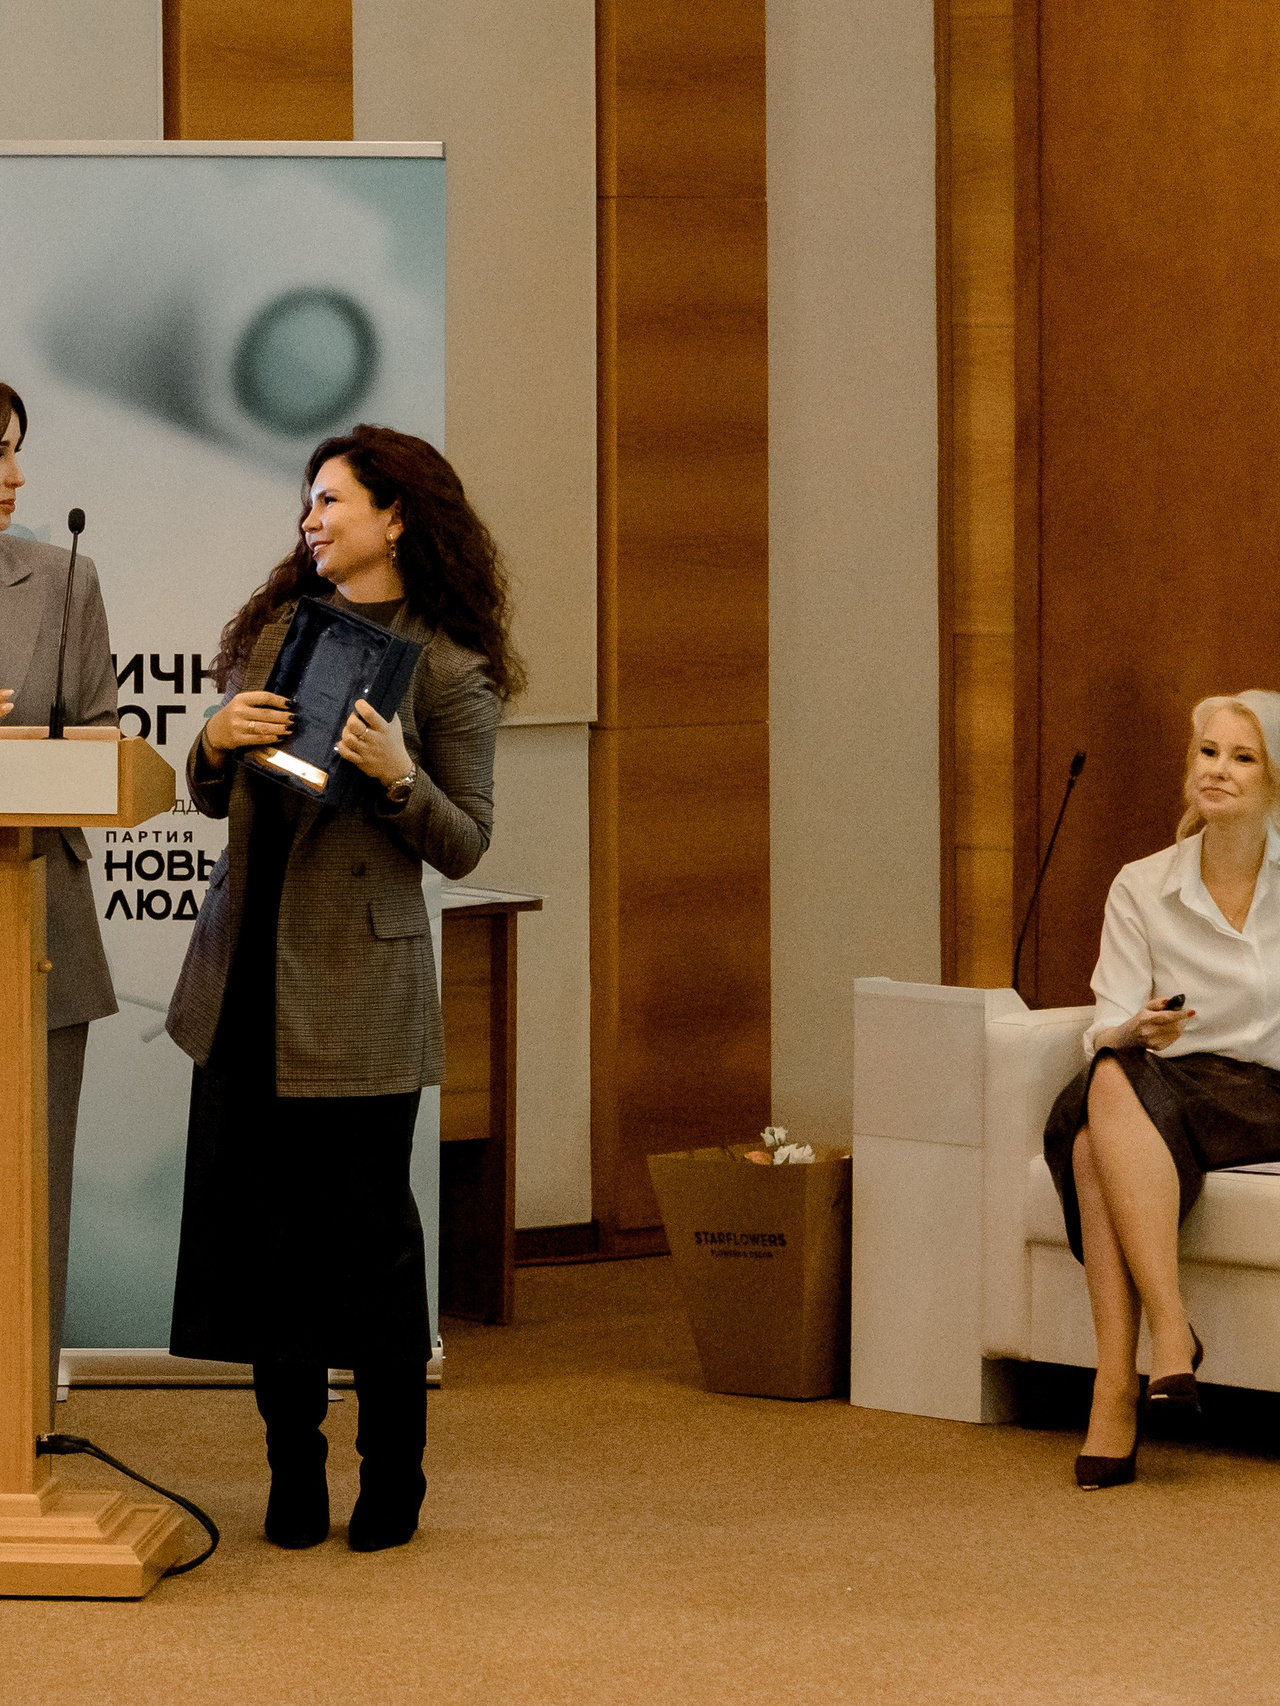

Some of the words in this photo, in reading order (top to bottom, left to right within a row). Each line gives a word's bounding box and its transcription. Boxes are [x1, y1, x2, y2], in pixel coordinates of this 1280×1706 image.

[111, 653, 226, 695] ИЧН
[116, 704, 187, 746] ОГ
[105, 831, 194, 843] ПАРТИЯ
[104, 888, 208, 921] ЛЮД
[694, 1231, 787, 1247] STARFLOWERS
